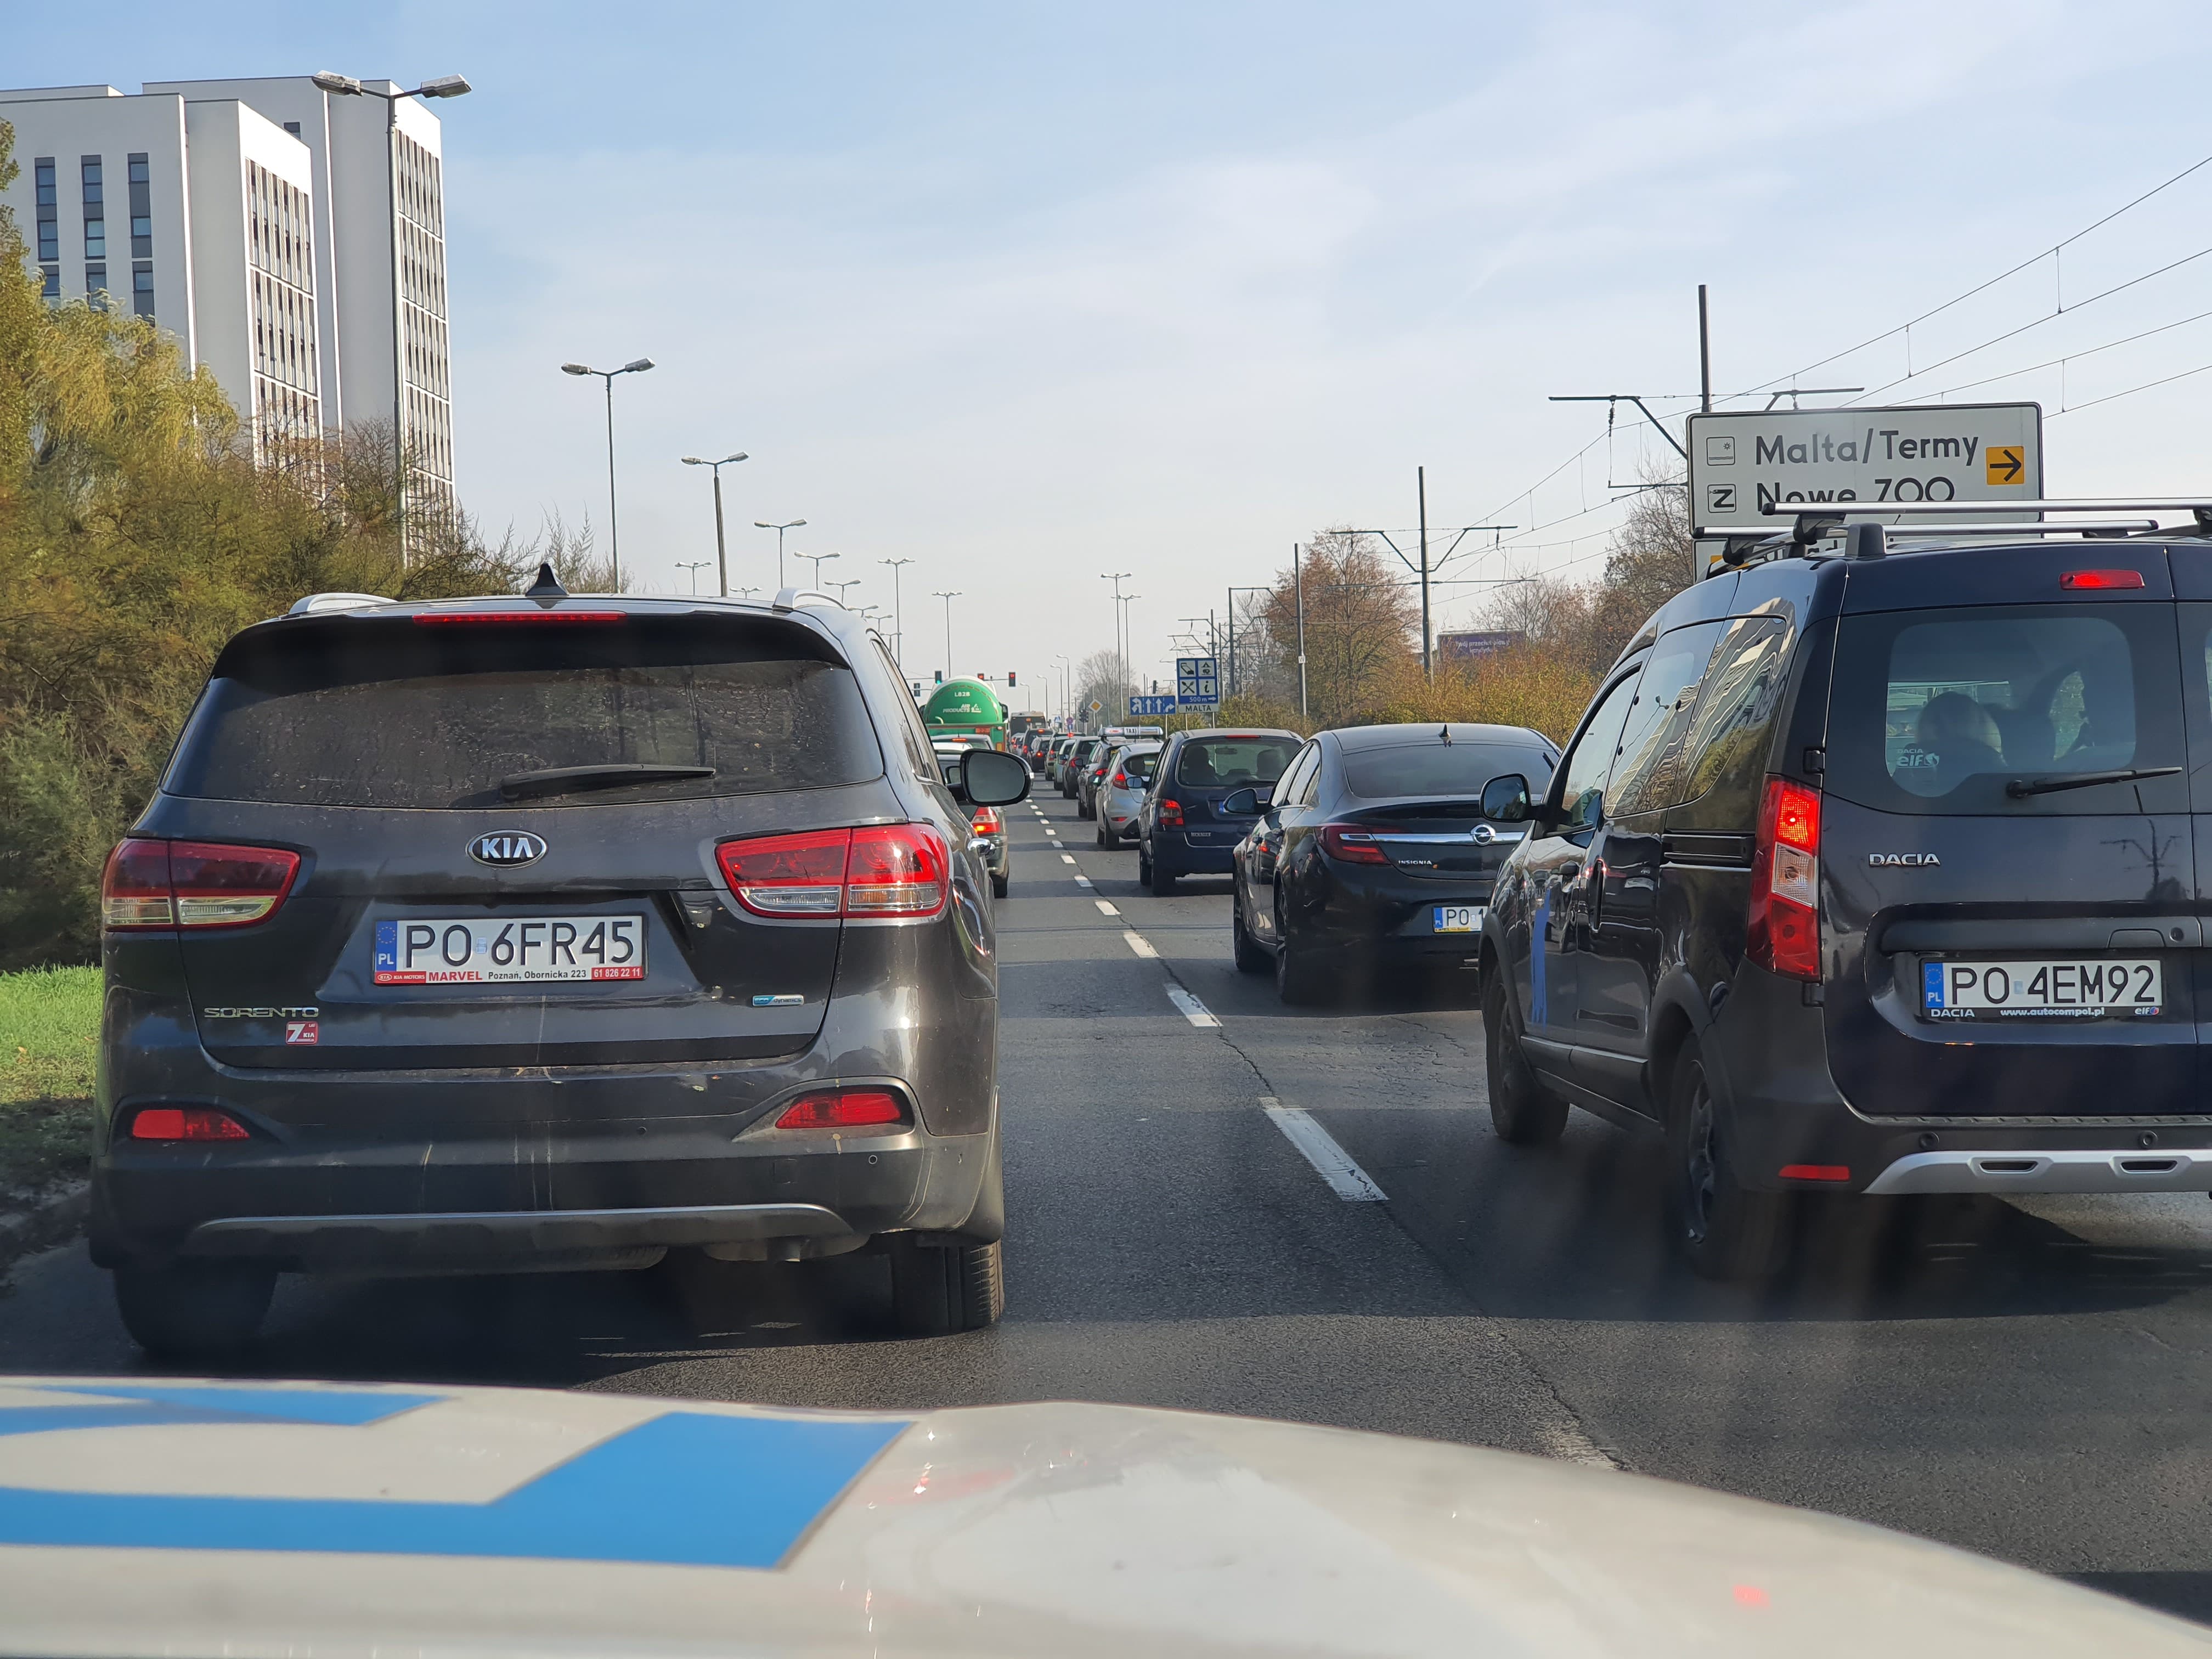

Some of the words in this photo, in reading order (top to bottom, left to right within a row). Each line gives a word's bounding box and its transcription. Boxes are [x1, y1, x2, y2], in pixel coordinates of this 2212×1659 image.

[1756, 428, 1978, 466] Malta/Termy
[1897, 754, 1923, 766] elf
[482, 837, 534, 859] KIA
[1869, 854, 1940, 866] DACIA
[1446, 909, 1469, 927] PO
[405, 924, 472, 968] PO
[491, 921, 633, 967] 6FR45
[378, 952, 394, 966] PL
[428, 971, 483, 981] MARVEL
[488, 970, 521, 980] Poznań,
[524, 970, 568, 979] Obornicka
[571, 969, 586, 978] 223
[594, 969, 603, 978] 61
[605, 968, 619, 977] 826
[620, 968, 630, 977] 22
[632, 968, 641, 976] 11
[1951, 967, 2010, 1005] PO
[2027, 965, 2155, 1005] 4EM92
[1928, 992, 1941, 1003] PL
[204, 1007, 319, 1018] SORENTO
[1931, 1009, 1975, 1018] DACIA
[2000, 1007, 2104, 1018] www.autocompol.pl
[287, 1024, 306, 1042] 7
